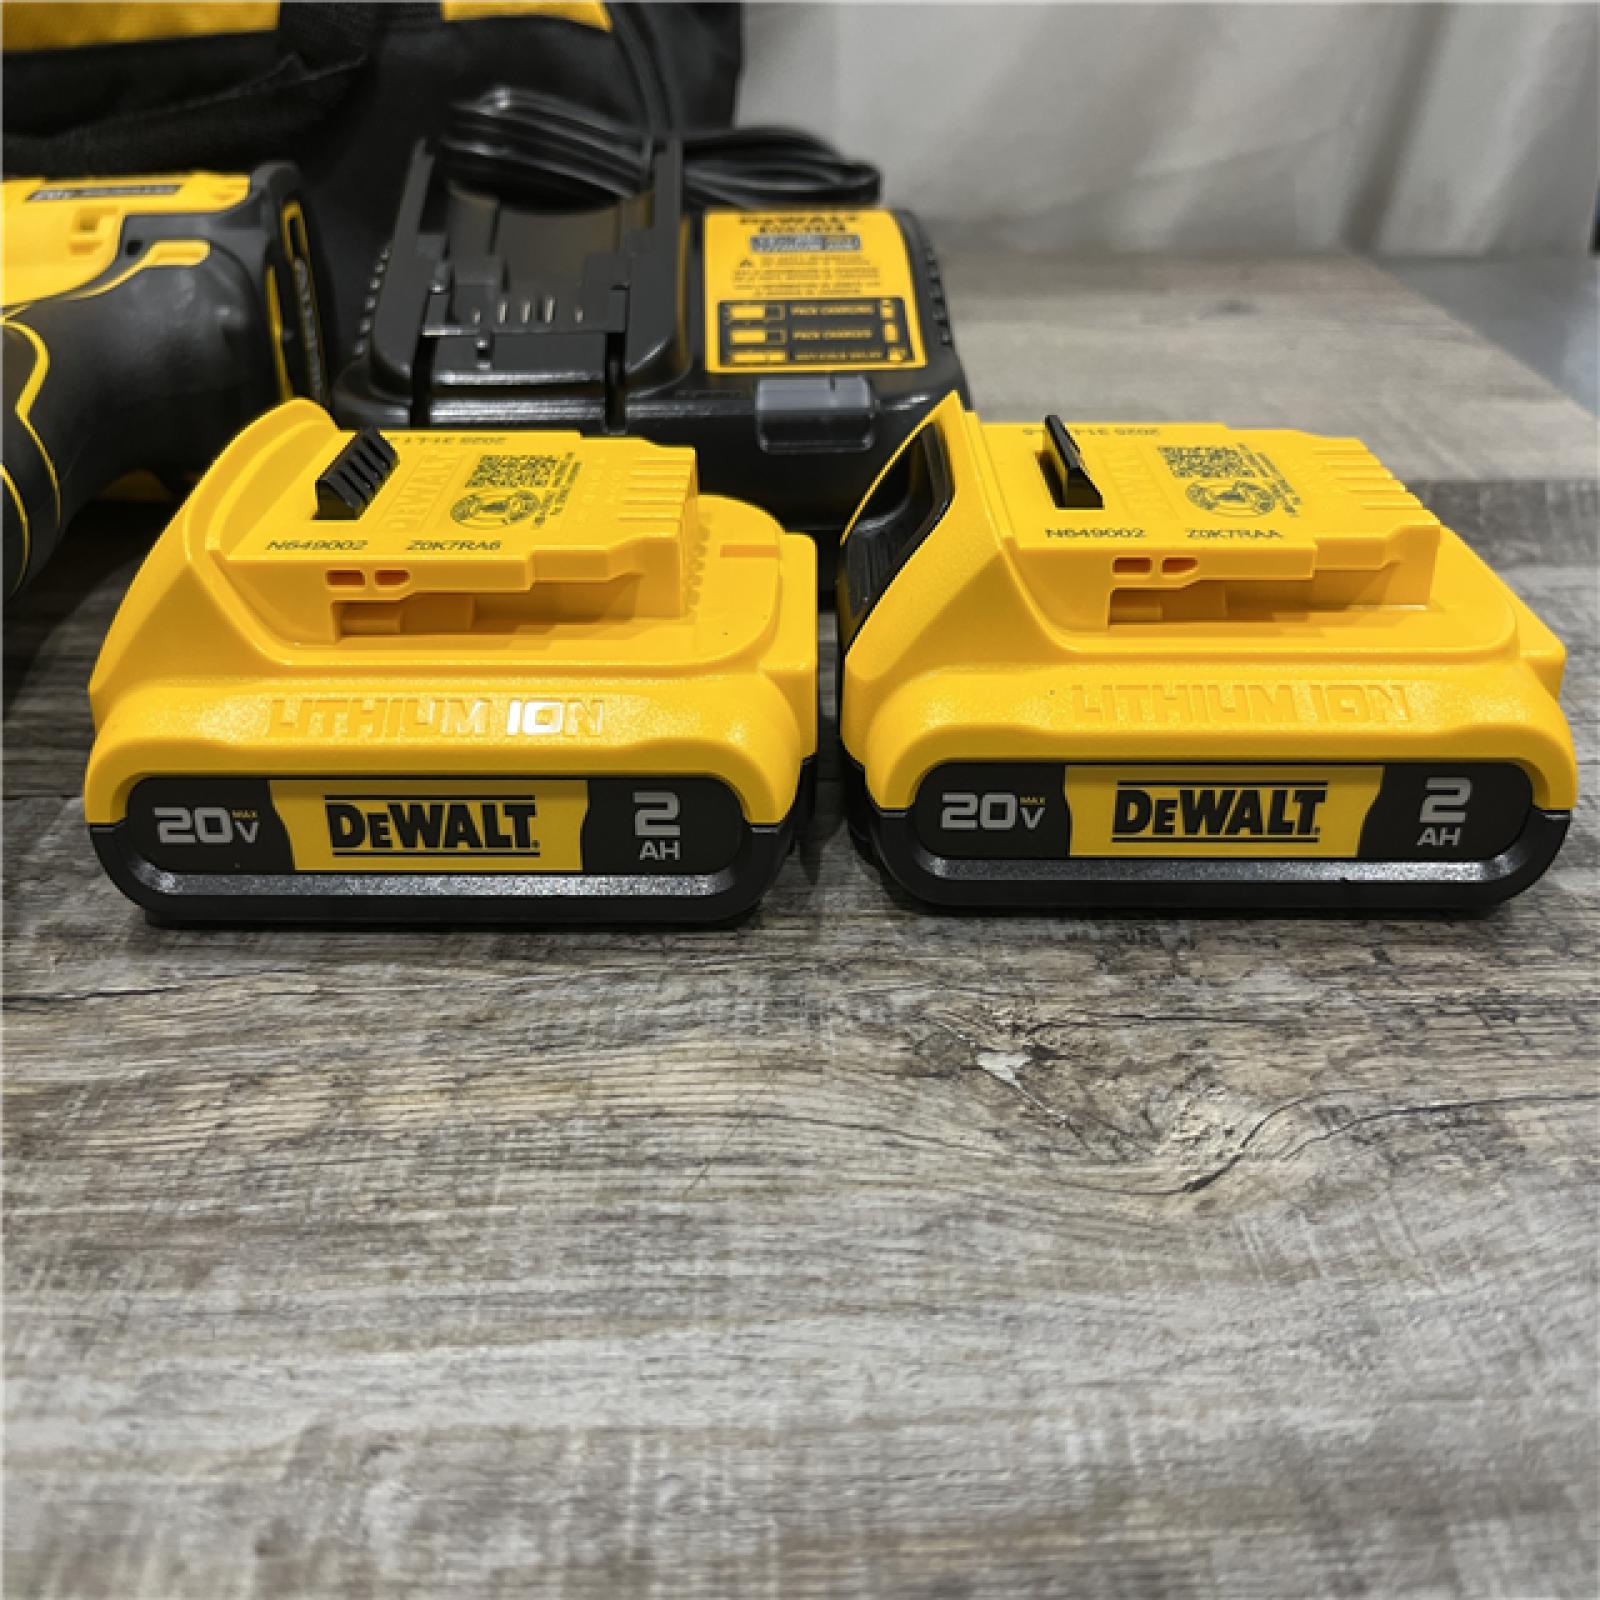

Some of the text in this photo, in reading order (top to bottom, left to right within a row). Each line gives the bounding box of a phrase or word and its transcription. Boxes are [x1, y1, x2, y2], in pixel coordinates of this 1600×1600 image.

[264, 699, 605, 739] LITHIUM ION
[1070, 684, 1409, 724] LITHIUM ION
[633, 791, 681, 837] 2
[1419, 777, 1472, 824] 2
[639, 840, 681, 861] AH
[1417, 827, 1462, 846] AH
